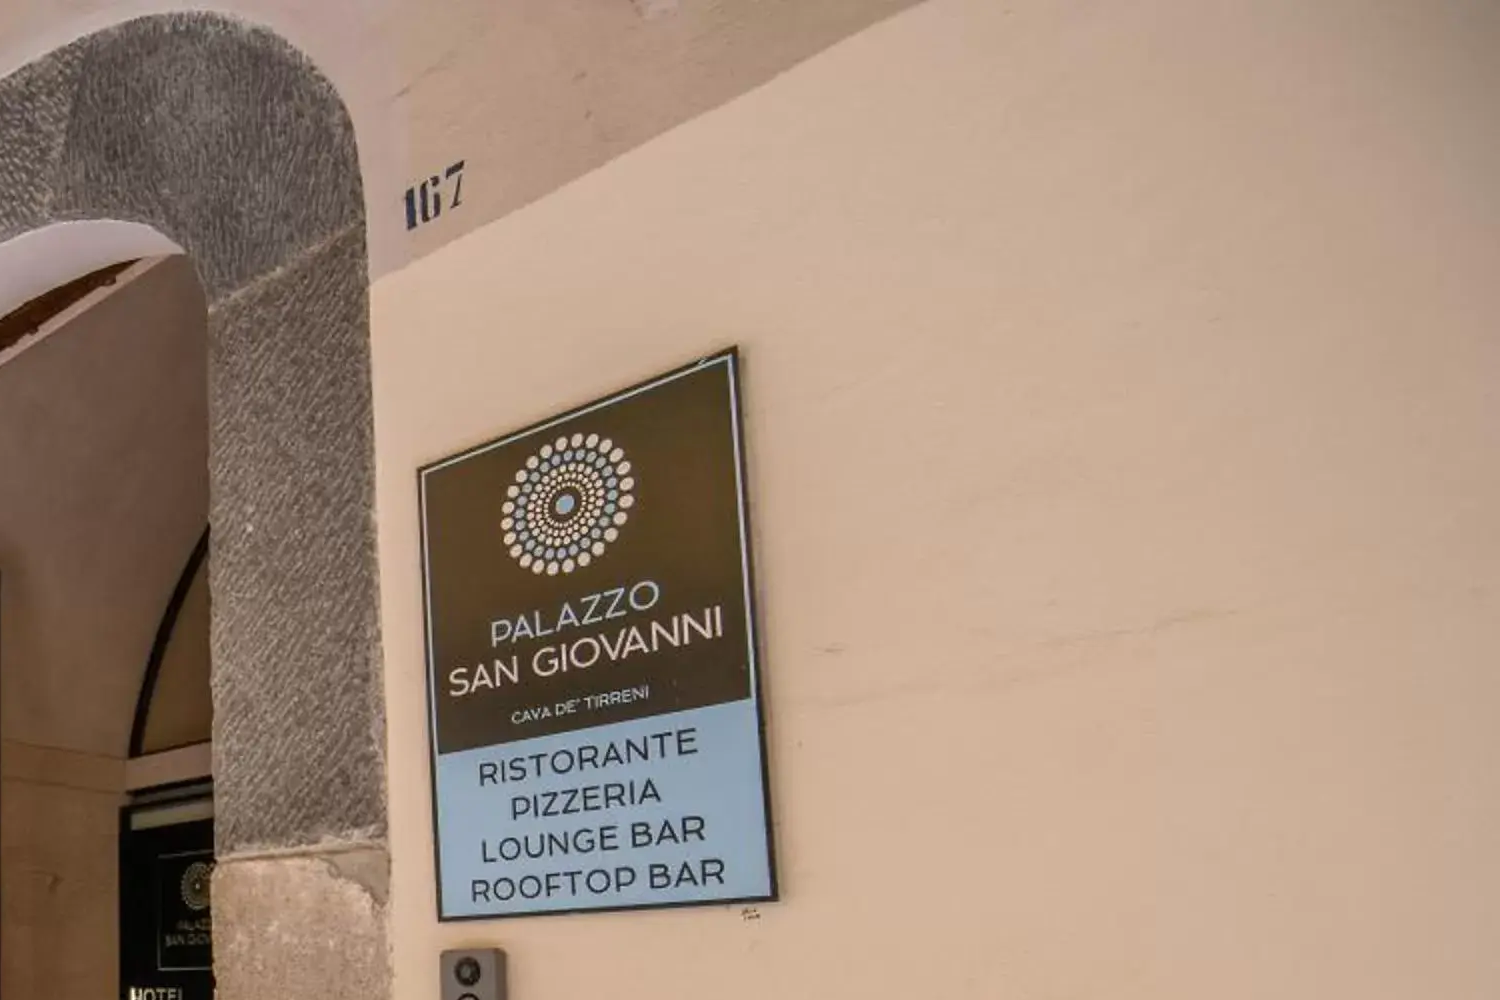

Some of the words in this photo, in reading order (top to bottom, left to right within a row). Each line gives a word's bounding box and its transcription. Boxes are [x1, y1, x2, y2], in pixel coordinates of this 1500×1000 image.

[405, 160, 465, 231] 167
[491, 580, 660, 648] PALAZZO
[449, 655, 519, 697] SAN
[532, 605, 724, 678] GIOVANNI
[511, 707, 552, 724] CAVA
[583, 685, 650, 711] TIRRENI
[479, 727, 699, 787] RISTORANTE
[511, 778, 662, 821] PIZZERIA
[481, 826, 620, 863] LOUNGE
[631, 815, 706, 849] BAR
[471, 866, 636, 903] ROOFTOP
[649, 858, 725, 889] BAR
